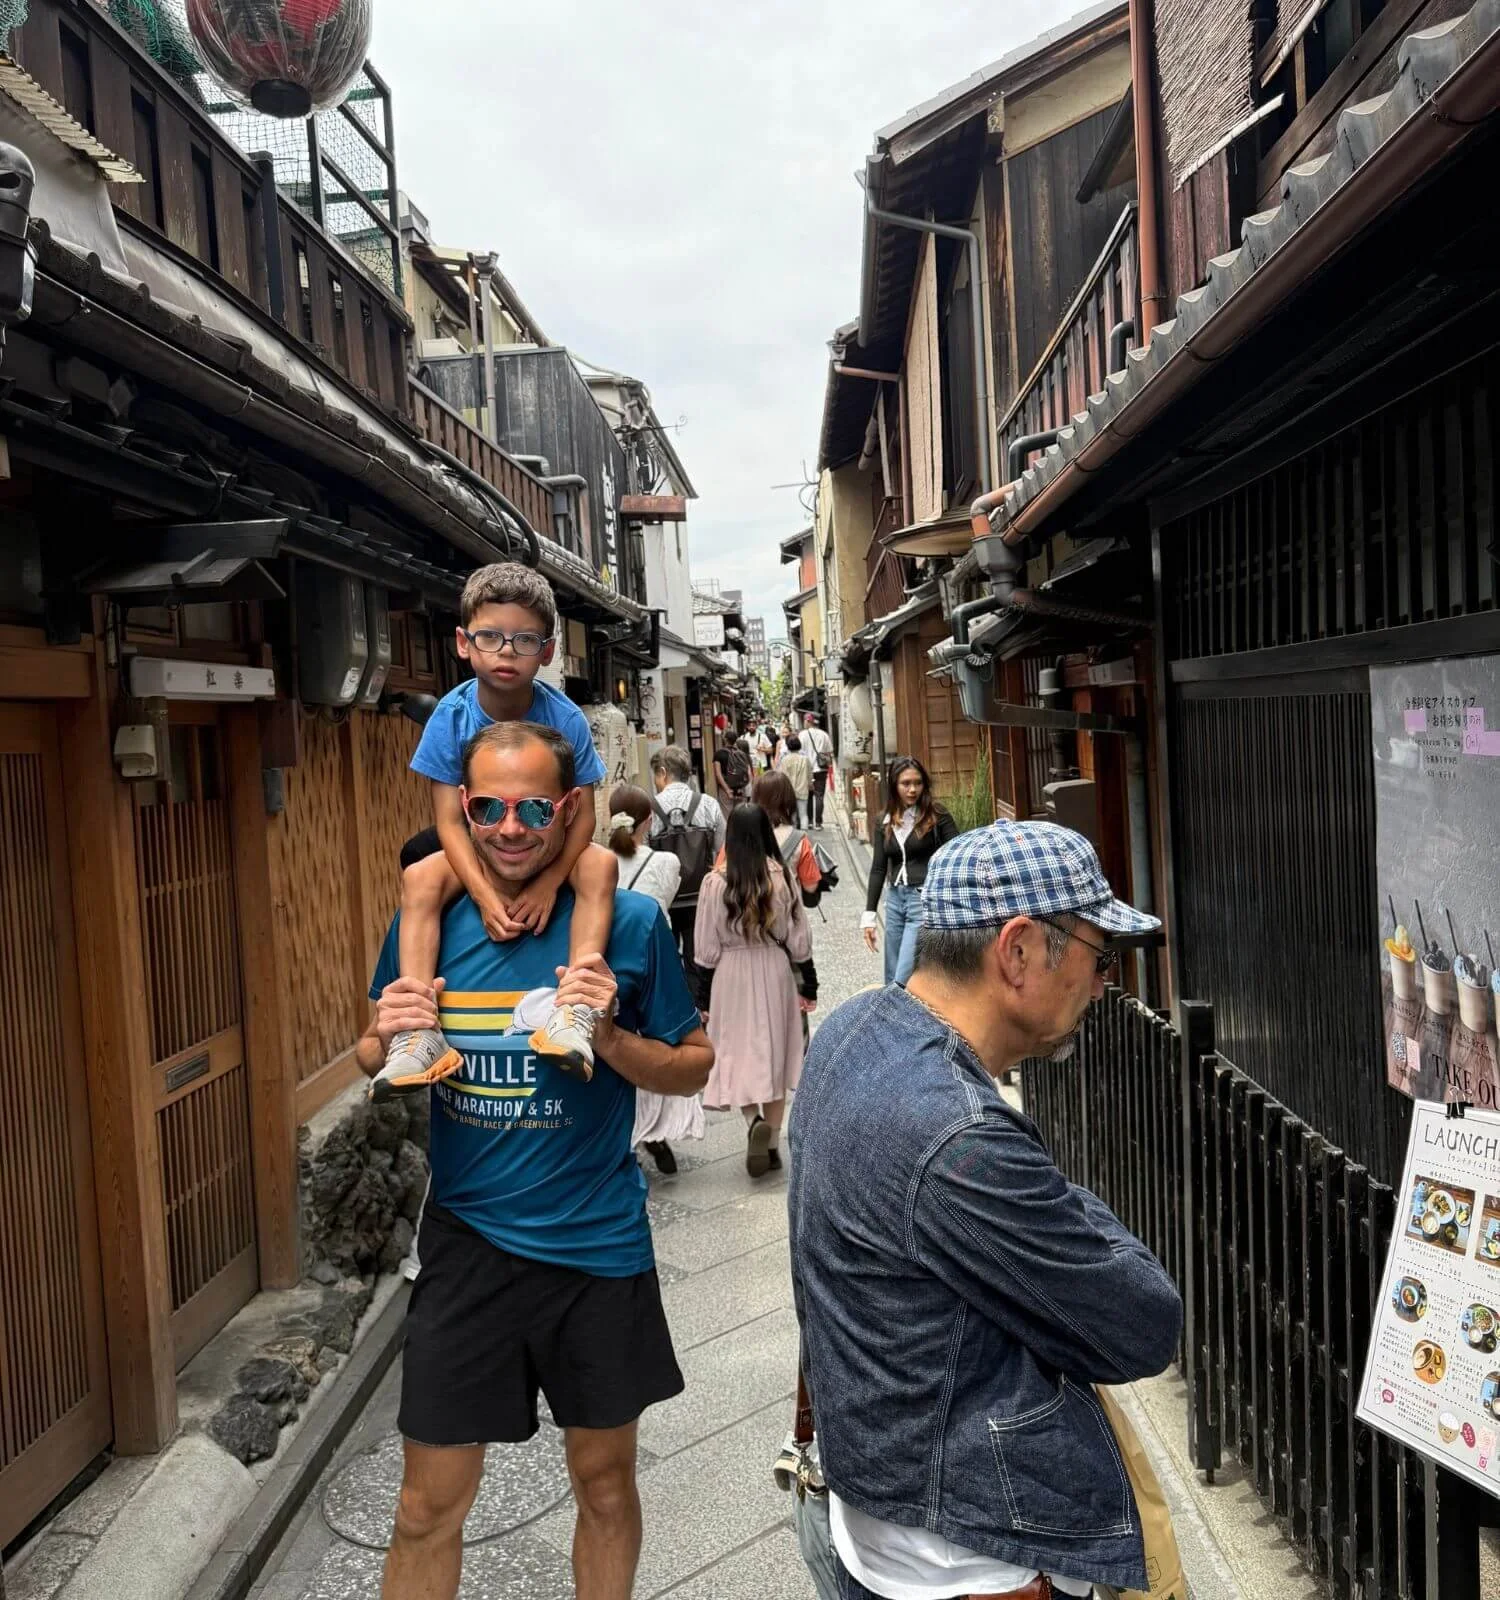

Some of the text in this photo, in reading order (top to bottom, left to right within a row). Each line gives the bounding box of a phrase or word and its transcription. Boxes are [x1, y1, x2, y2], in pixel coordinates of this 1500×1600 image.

[455, 1053, 537, 1084] VILLE
[1432, 1053, 1473, 1096] TAKE
[454, 1096, 524, 1117] MARATHON
[528, 1102, 538, 1116] &
[544, 1098, 564, 1115] 5K
[483, 1120, 503, 1130] RACE
[1424, 1123, 1498, 1160] LAUNCH
